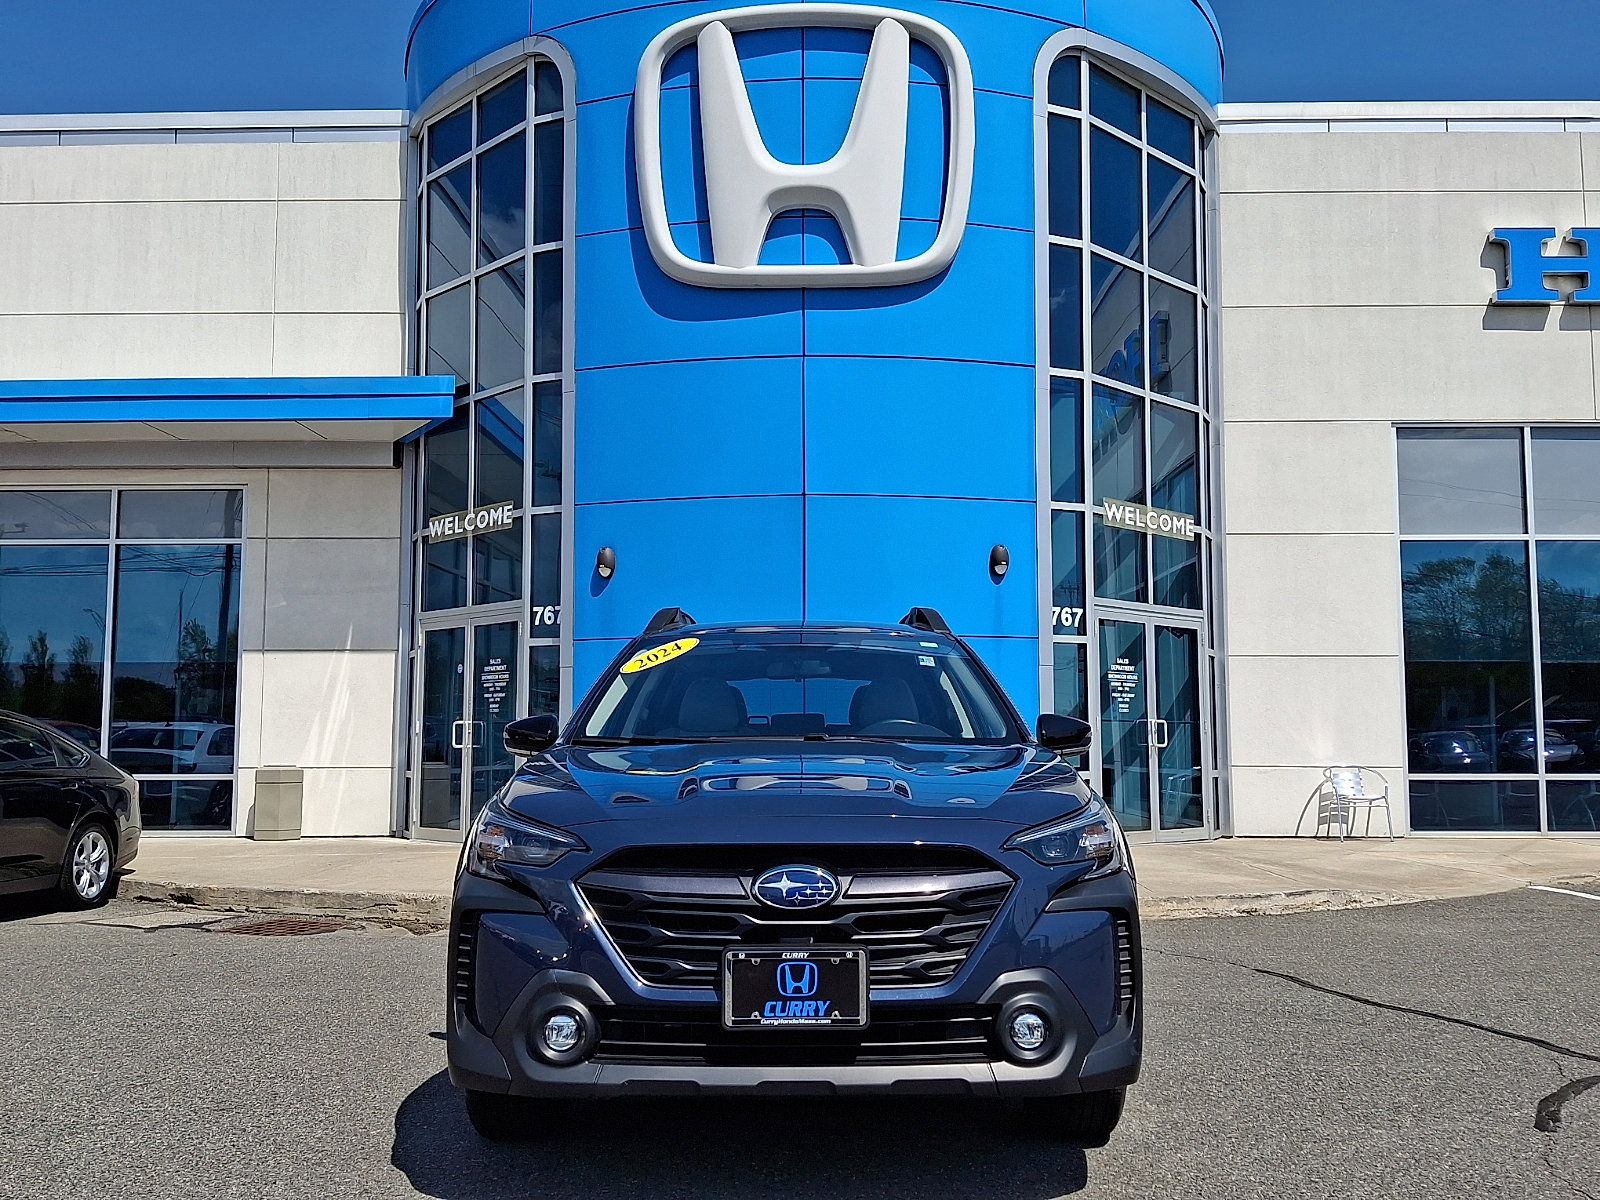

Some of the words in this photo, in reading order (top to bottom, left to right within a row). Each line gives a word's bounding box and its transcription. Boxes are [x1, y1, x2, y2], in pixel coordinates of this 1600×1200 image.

[429, 505, 513, 538] WELCOME
[1103, 501, 1195, 537] WELCOME
[1051, 606, 1084, 628] 767
[633, 642, 682, 669] 2024
[781, 951, 810, 959] CURRY
[763, 1000, 831, 1017] CURRY
